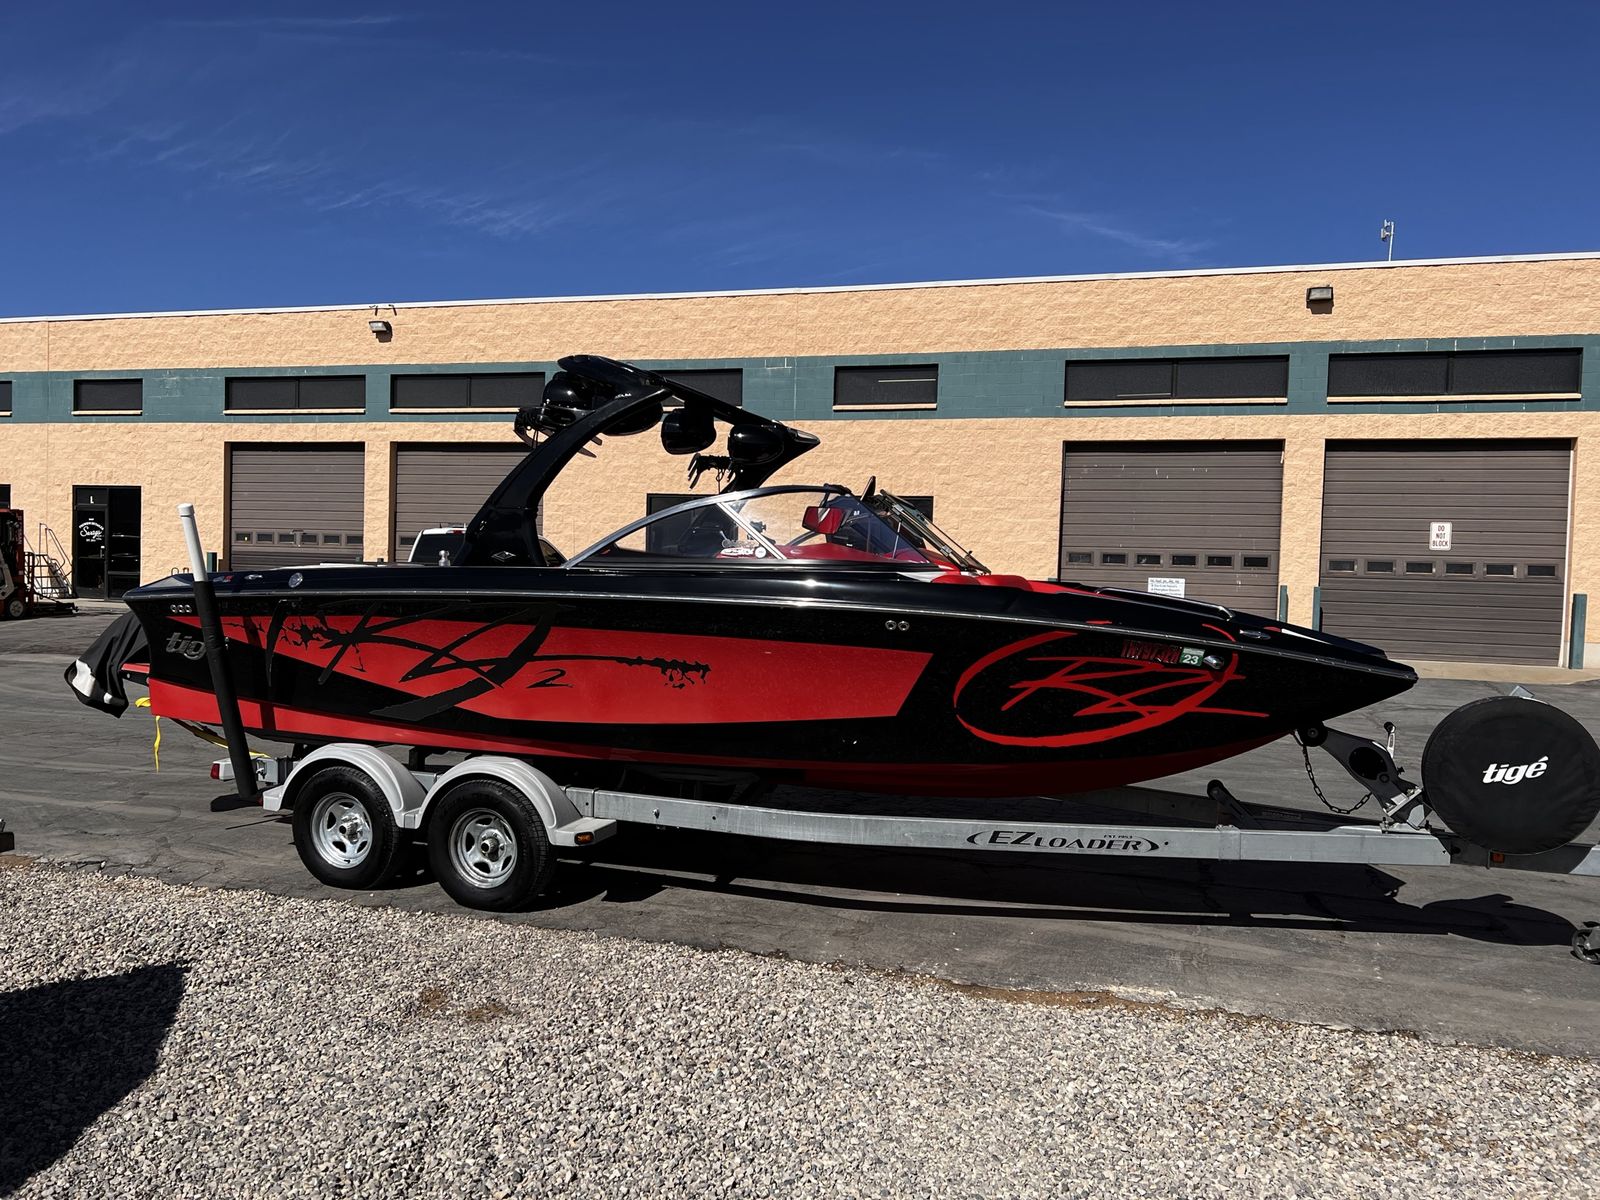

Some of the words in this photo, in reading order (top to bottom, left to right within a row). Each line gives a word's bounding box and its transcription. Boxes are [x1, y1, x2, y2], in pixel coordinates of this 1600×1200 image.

[165, 631, 208, 661] tig
[1182, 654, 1200, 665] 23
[1482, 755, 1549, 785] tigé
